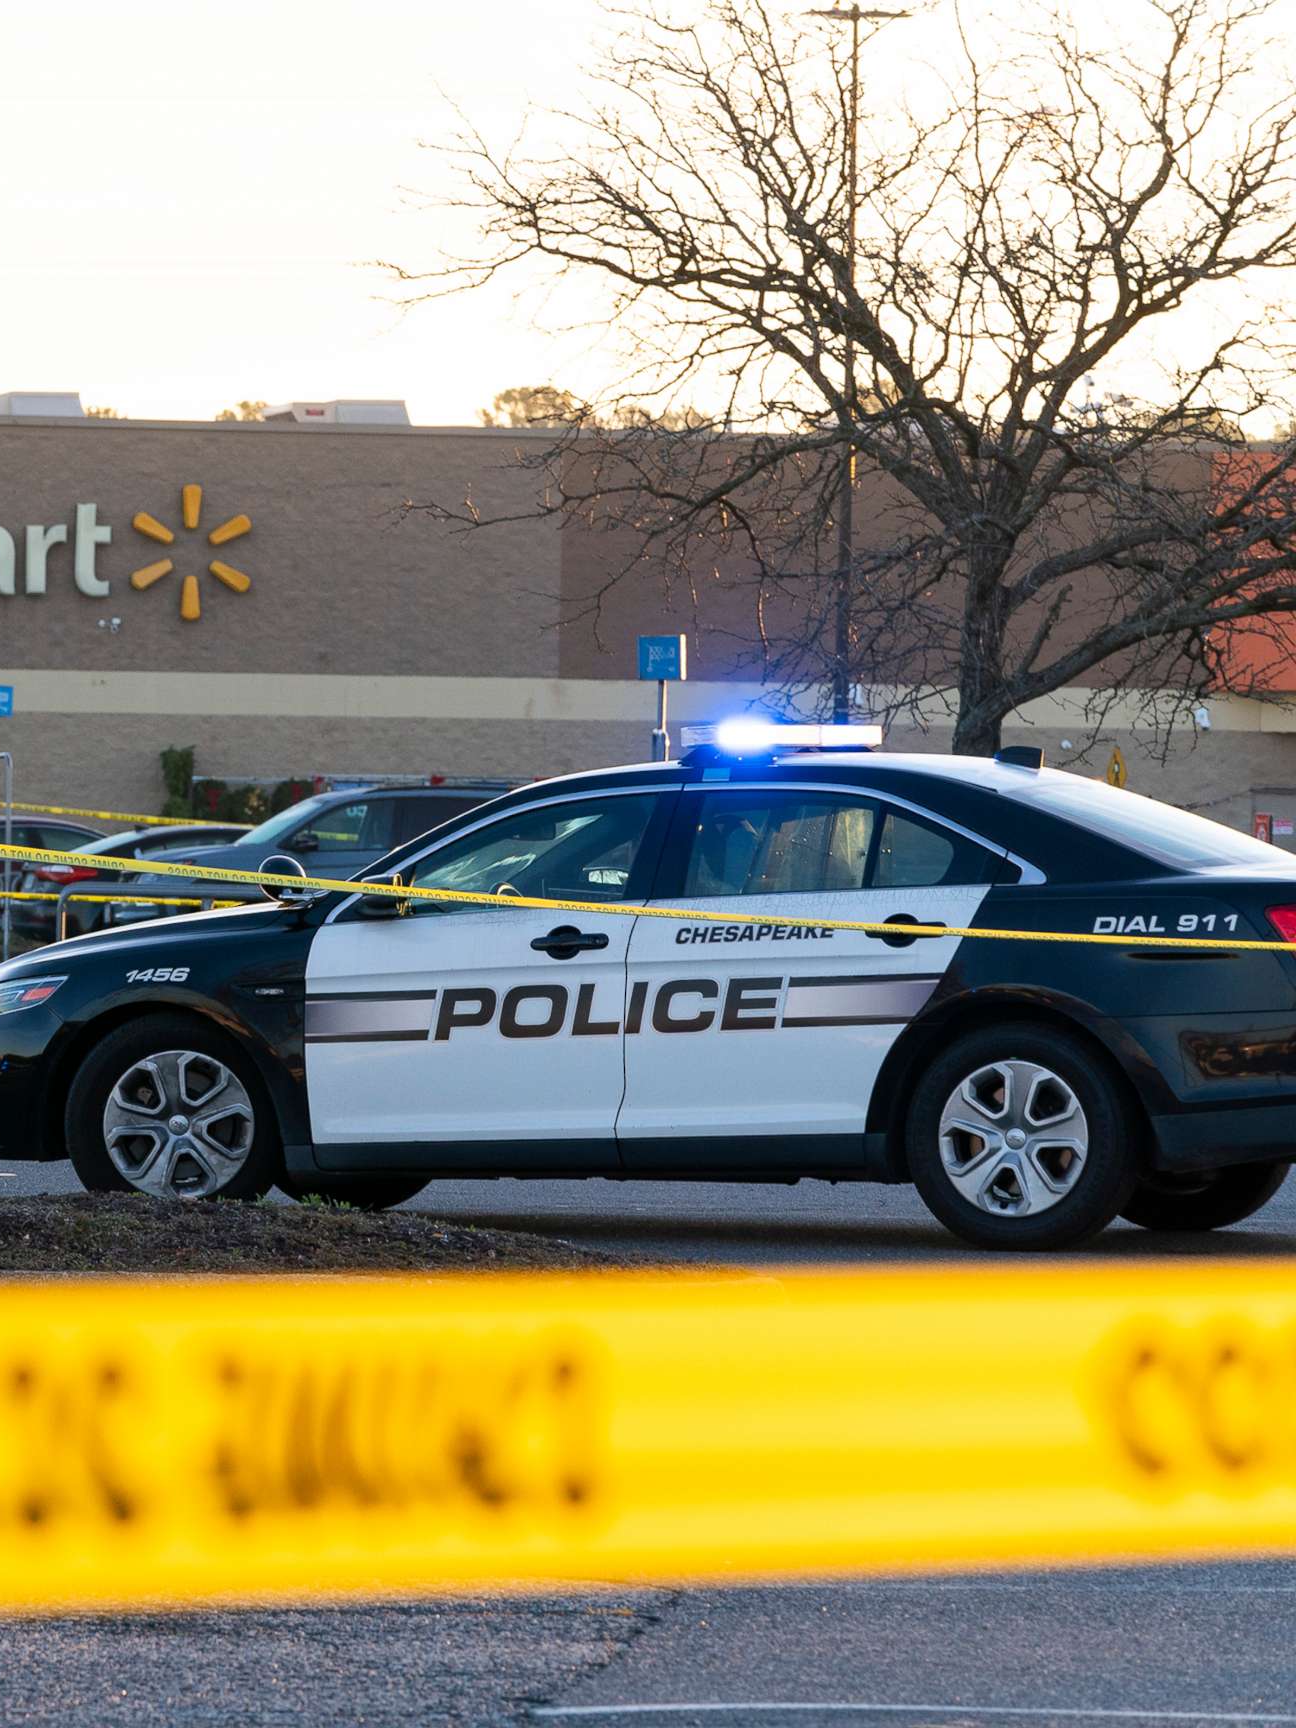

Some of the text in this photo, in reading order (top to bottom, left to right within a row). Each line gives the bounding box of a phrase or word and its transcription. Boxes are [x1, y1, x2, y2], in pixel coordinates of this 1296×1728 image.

[1093, 913, 1239, 934] DIAL 911
[675, 925, 835, 945] CHESAPEAKE
[126, 967, 190, 983] 1456
[435, 976, 784, 1040] POLICE
